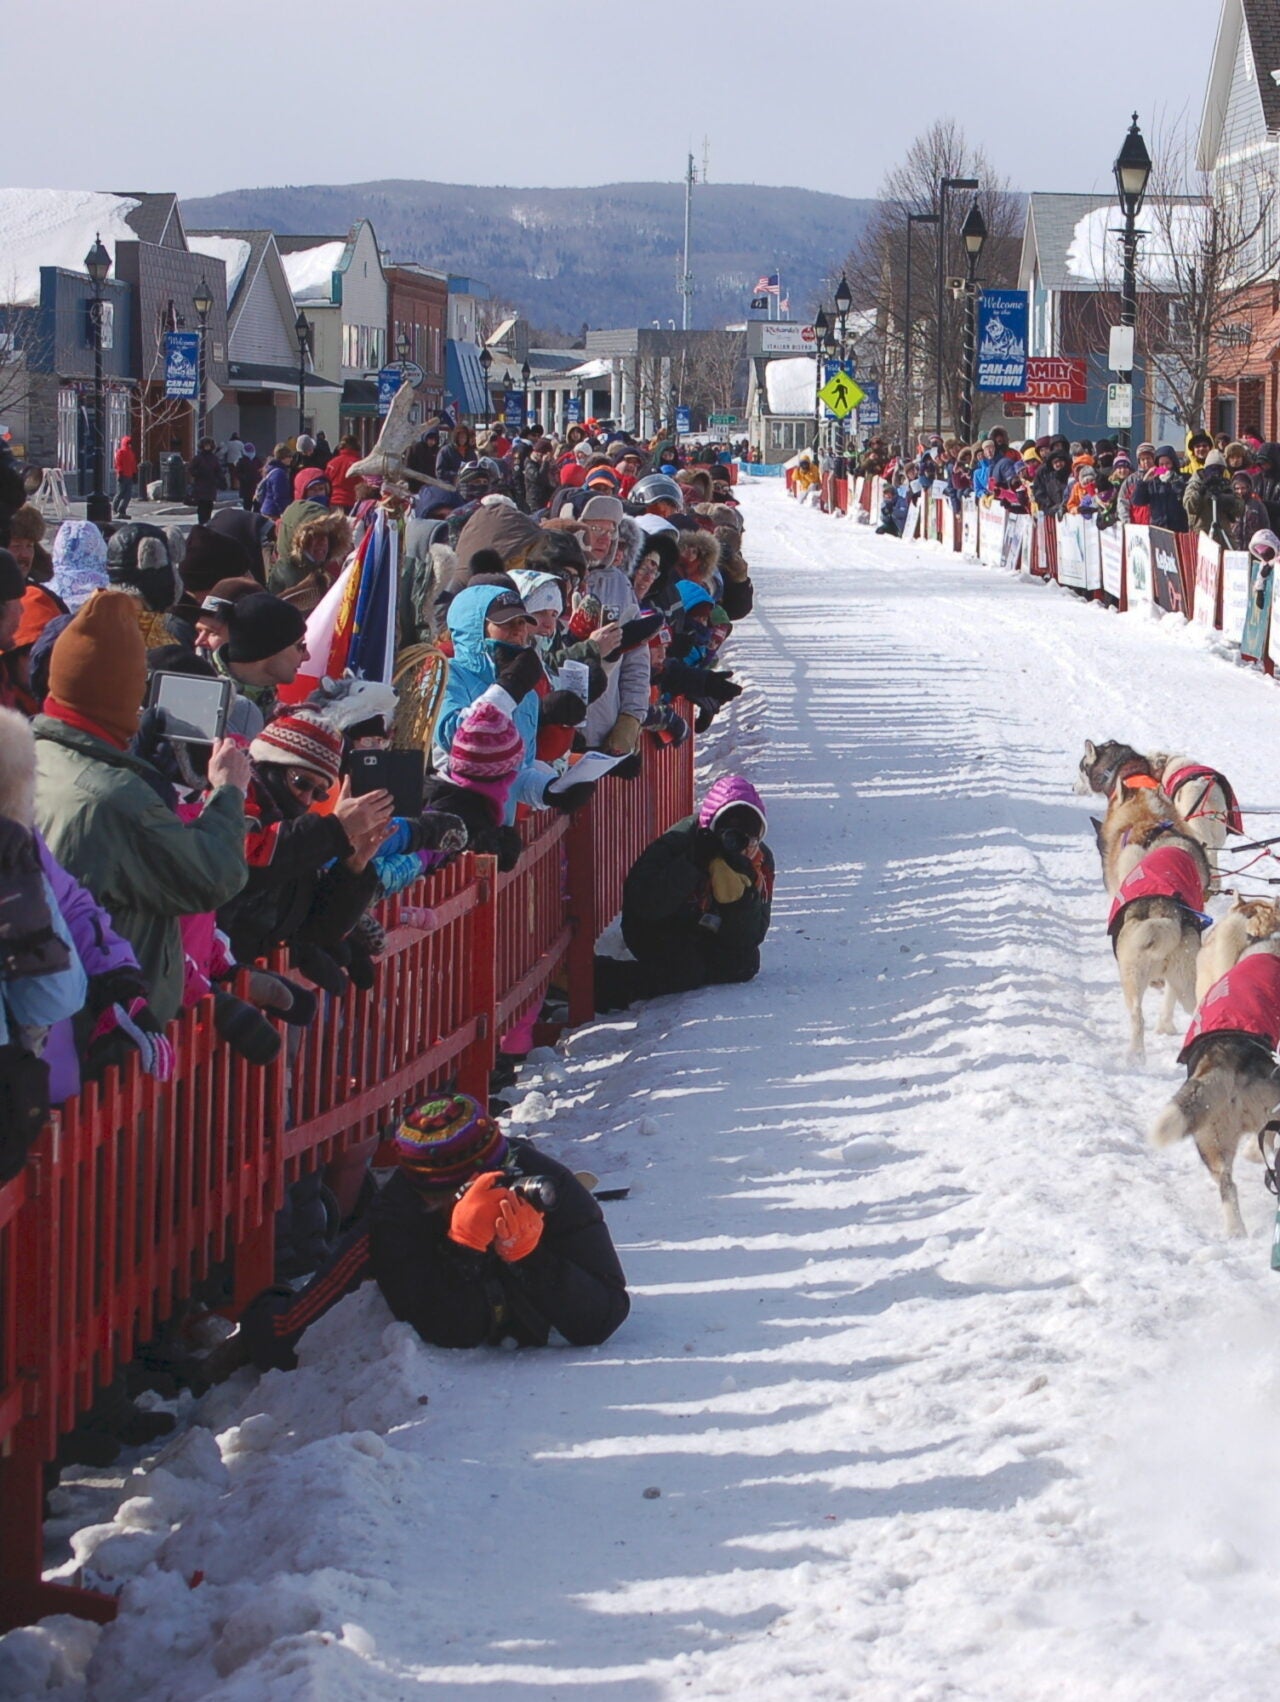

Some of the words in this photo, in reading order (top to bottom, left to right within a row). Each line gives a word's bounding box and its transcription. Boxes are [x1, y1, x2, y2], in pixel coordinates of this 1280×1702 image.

[982, 296, 1024, 309] Welcome
[979, 363, 1024, 375] CAN-AM
[1026, 362, 1072, 380] AMILY
[979, 375, 1022, 386] CROWN
[1015, 381, 1071, 400] OLLAR
